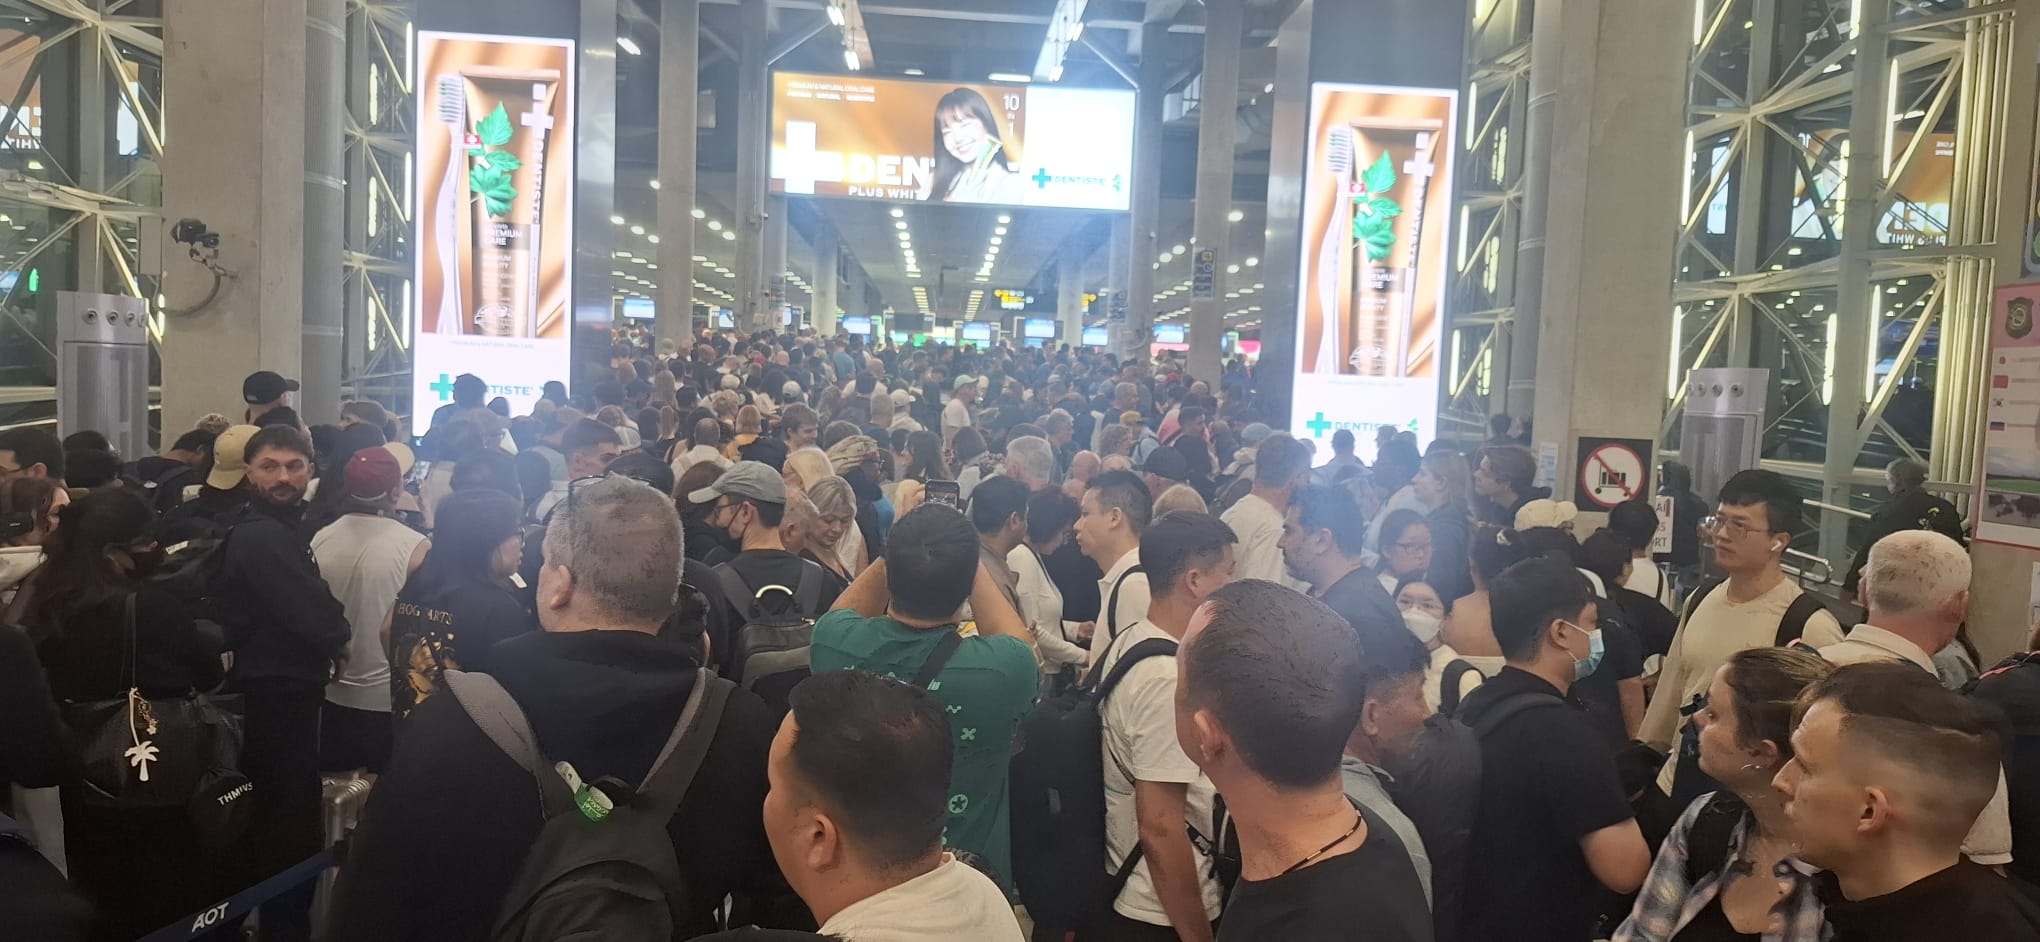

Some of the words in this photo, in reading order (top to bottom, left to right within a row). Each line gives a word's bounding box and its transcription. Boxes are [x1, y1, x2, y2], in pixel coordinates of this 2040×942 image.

[1003, 95, 1020, 111] 10
[849, 153, 936, 187] DEN
[848, 186, 884, 198] PLUS
[398, 602, 455, 625] HOGARTS
[191, 901, 230, 933] AOT
